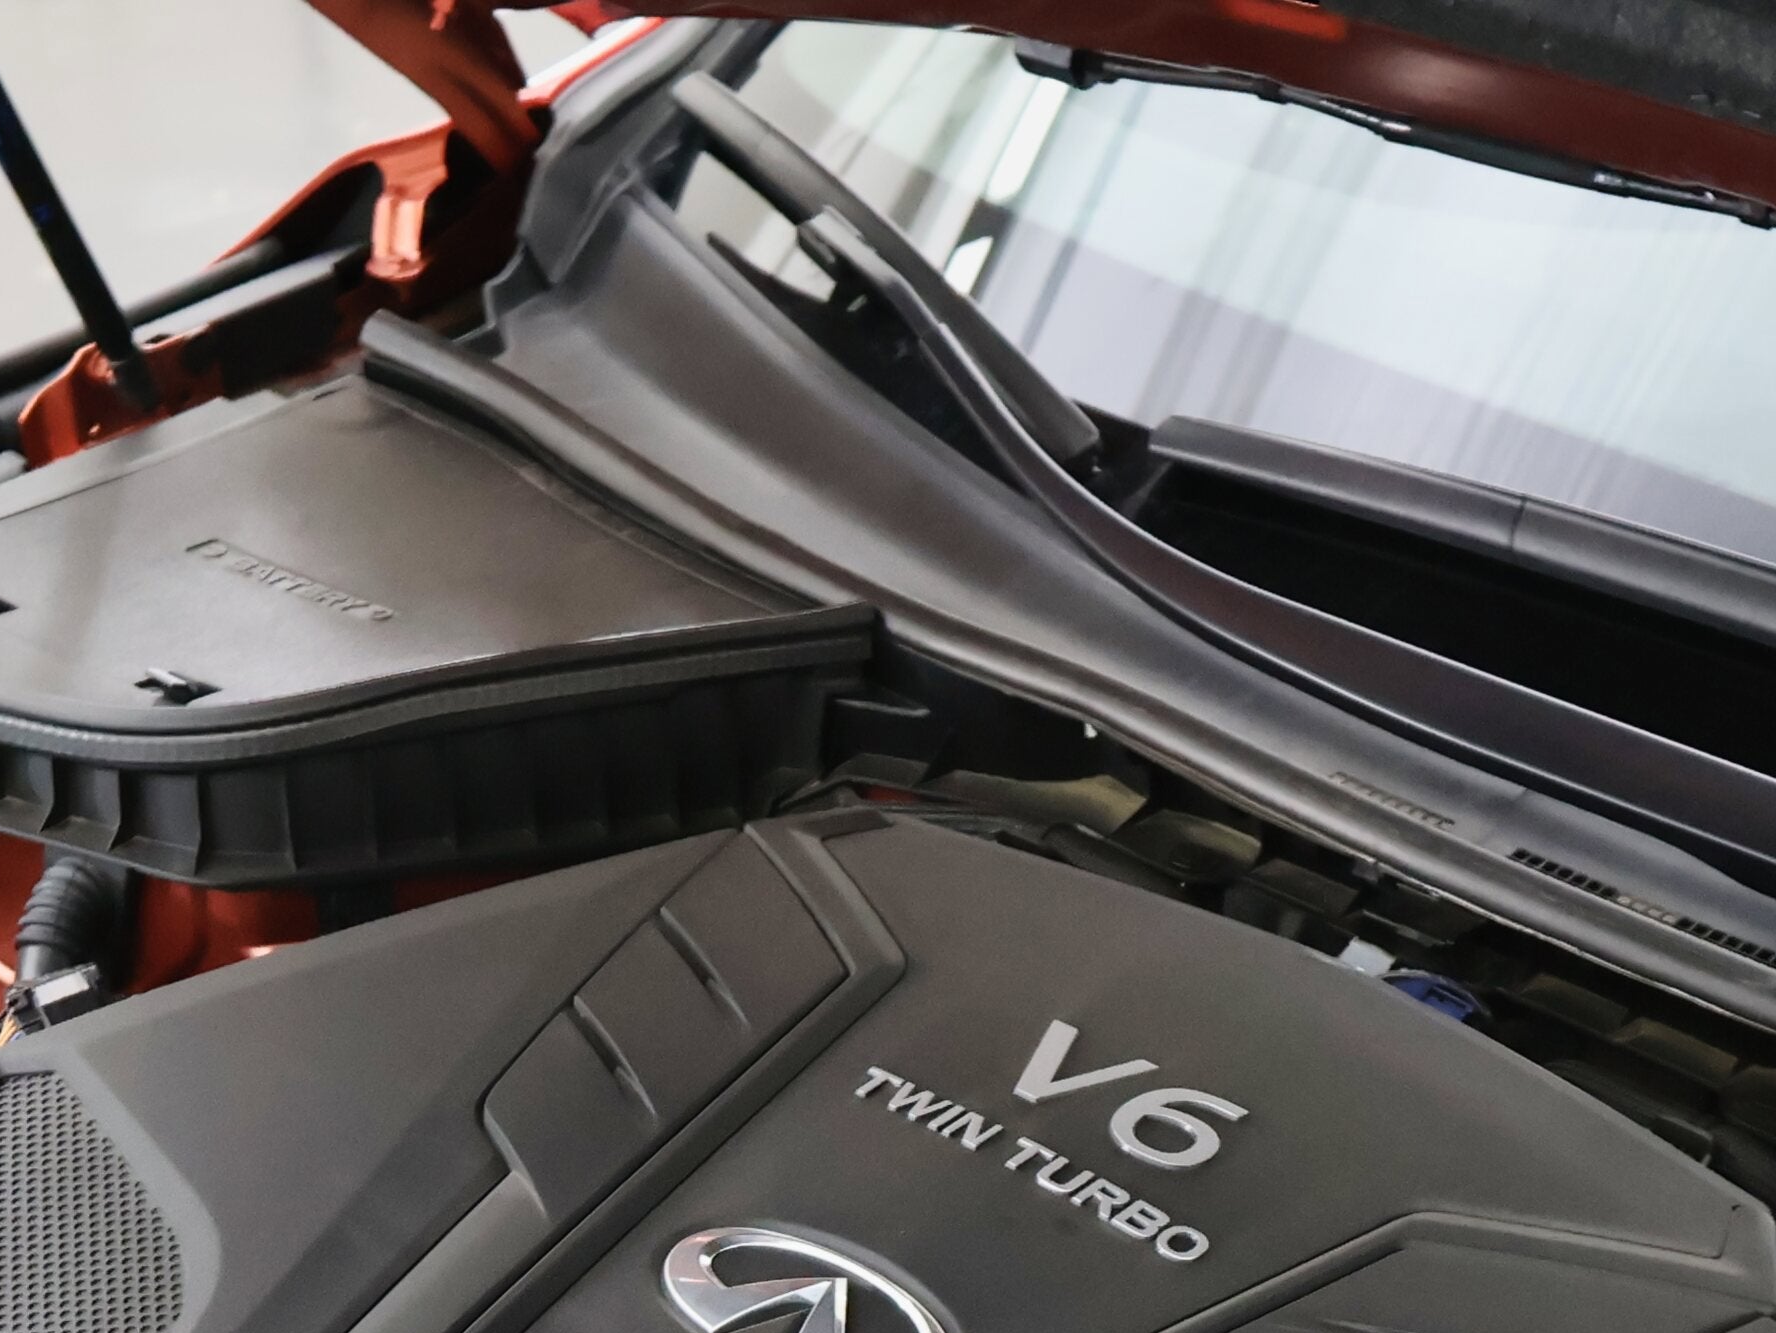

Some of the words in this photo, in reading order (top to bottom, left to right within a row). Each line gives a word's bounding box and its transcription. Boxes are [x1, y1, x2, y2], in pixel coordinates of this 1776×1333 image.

[854, 1064, 1005, 1152] TWIN
[1004, 1135, 1211, 1263] TURBO
[1012, 1018, 1250, 1169] V6
